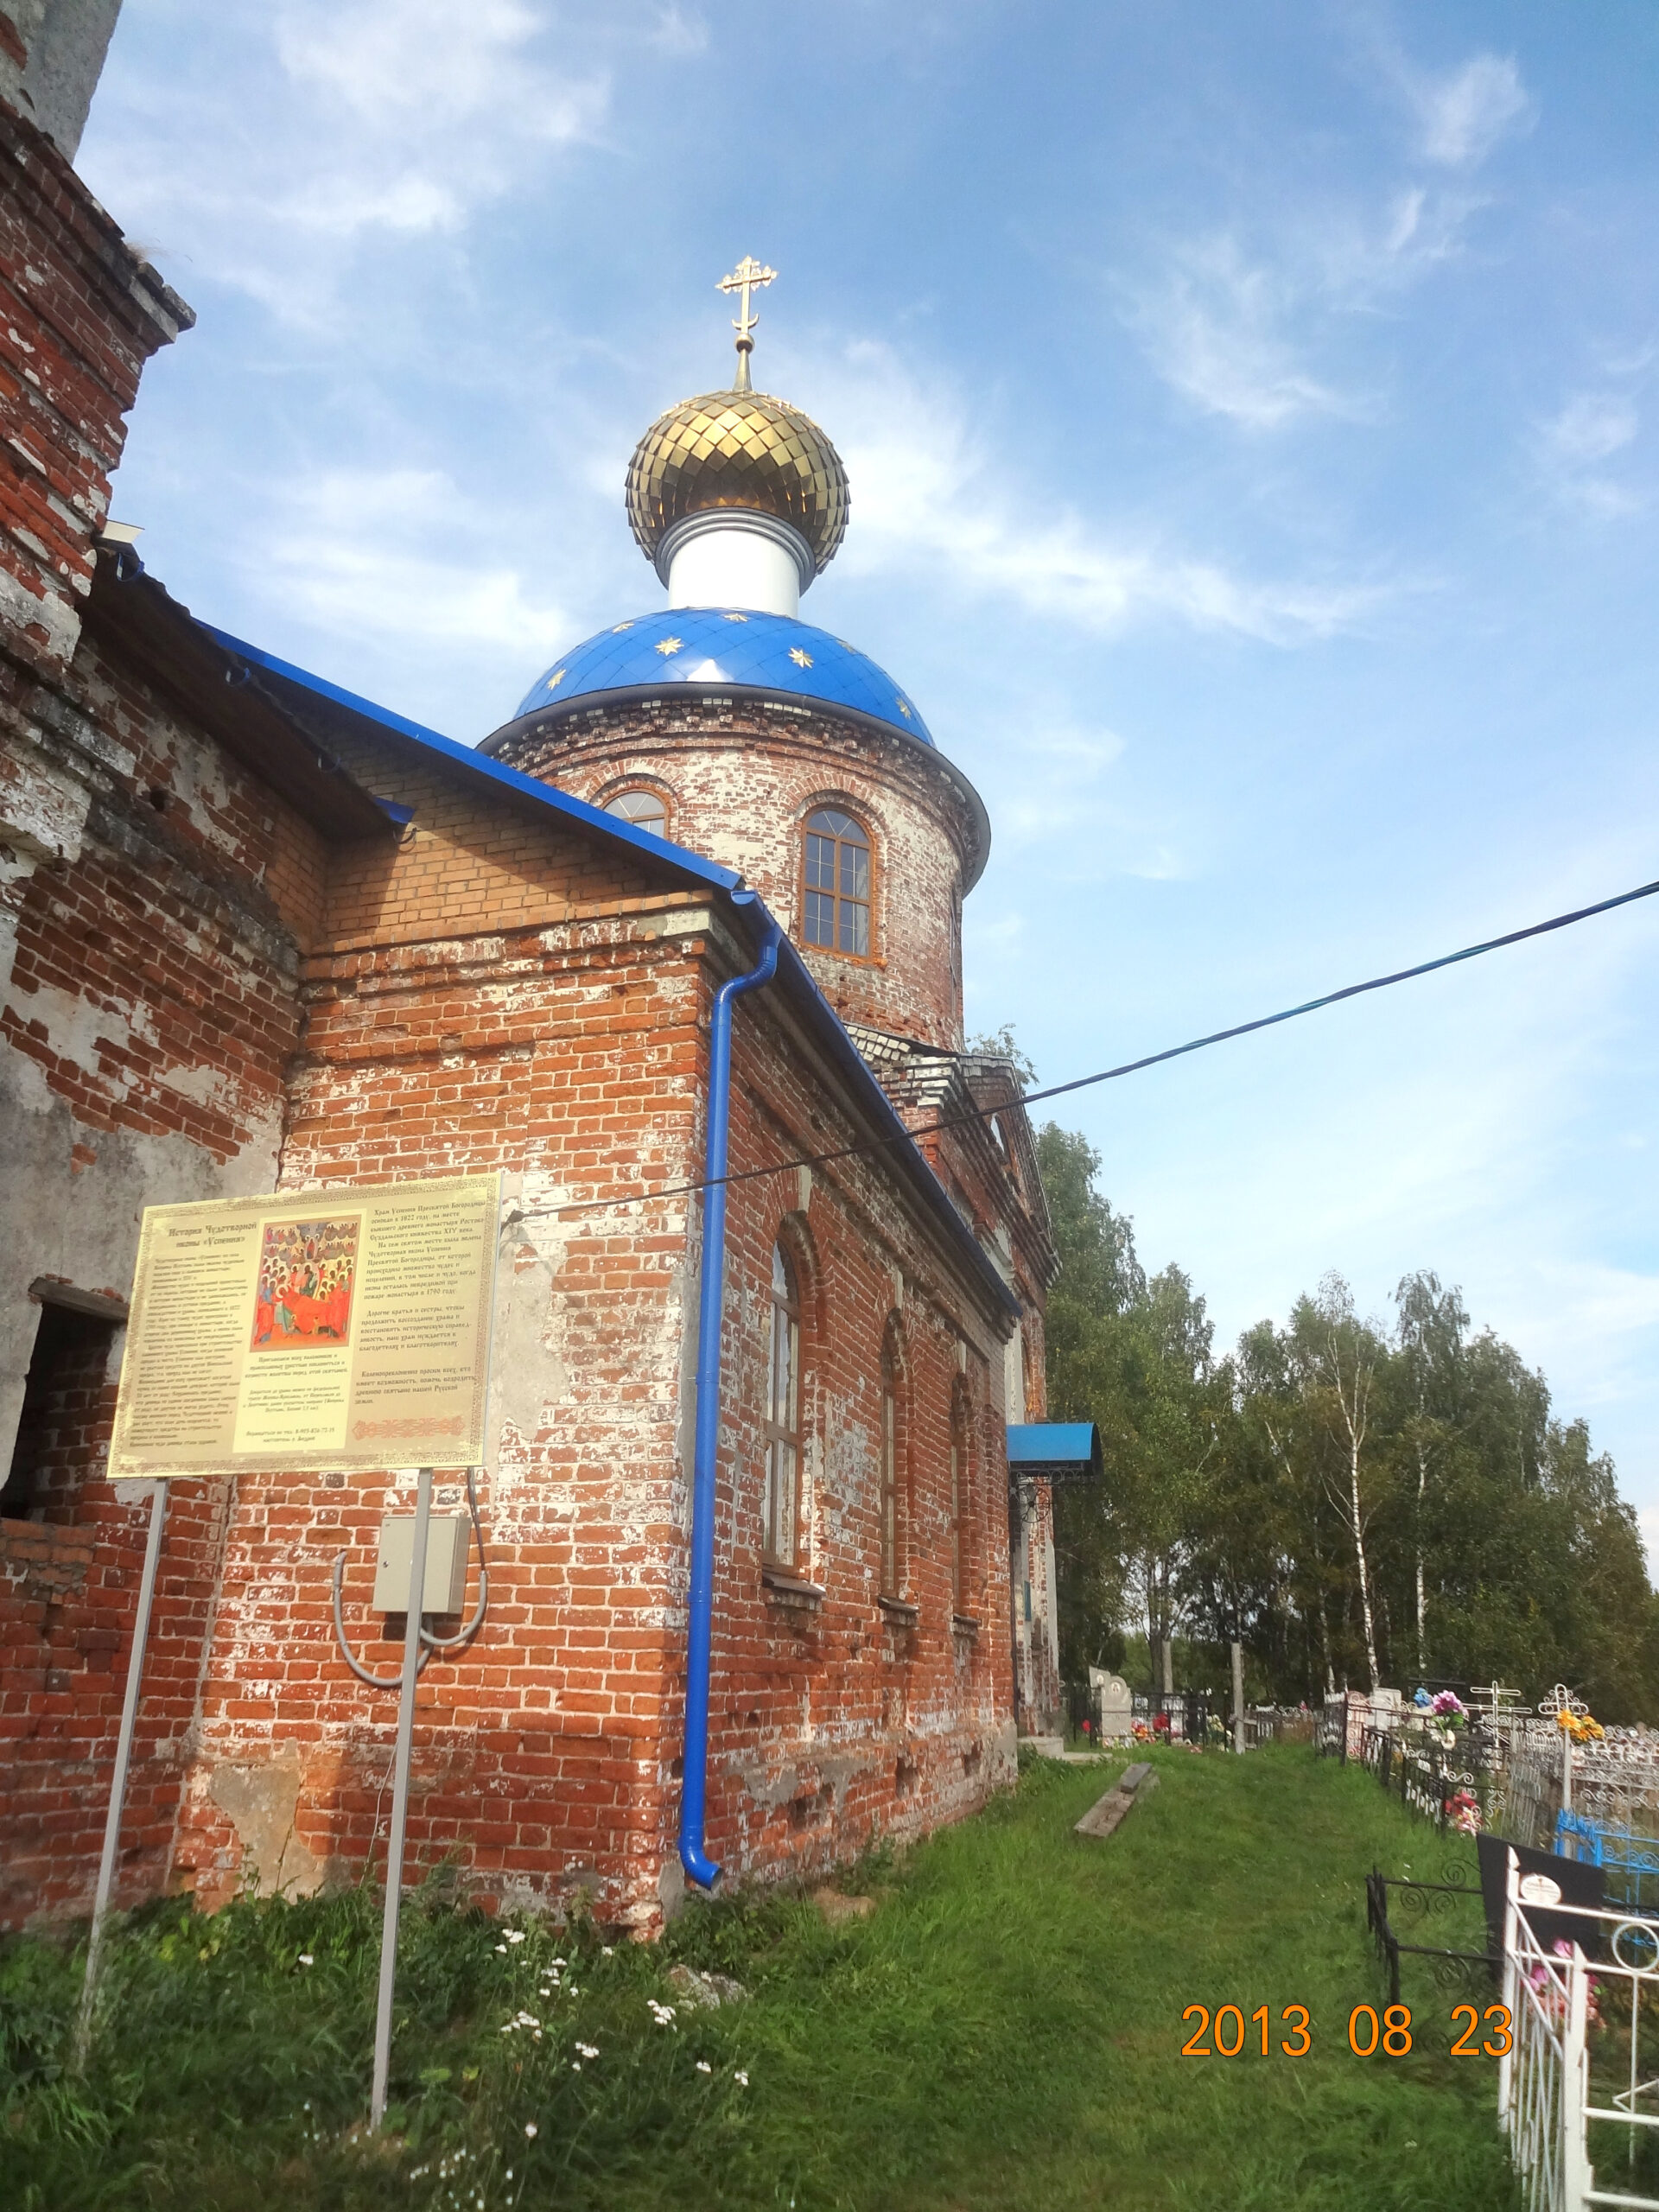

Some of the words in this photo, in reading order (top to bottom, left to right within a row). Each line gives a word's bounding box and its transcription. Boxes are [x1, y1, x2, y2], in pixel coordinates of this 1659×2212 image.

[206, 1222, 257, 1235] Чудотворной
[204, 1237, 245, 1246] «Успения»
[370, 1233, 408, 1242] Суздальского
[434, 1384, 458, 1393] Русской
